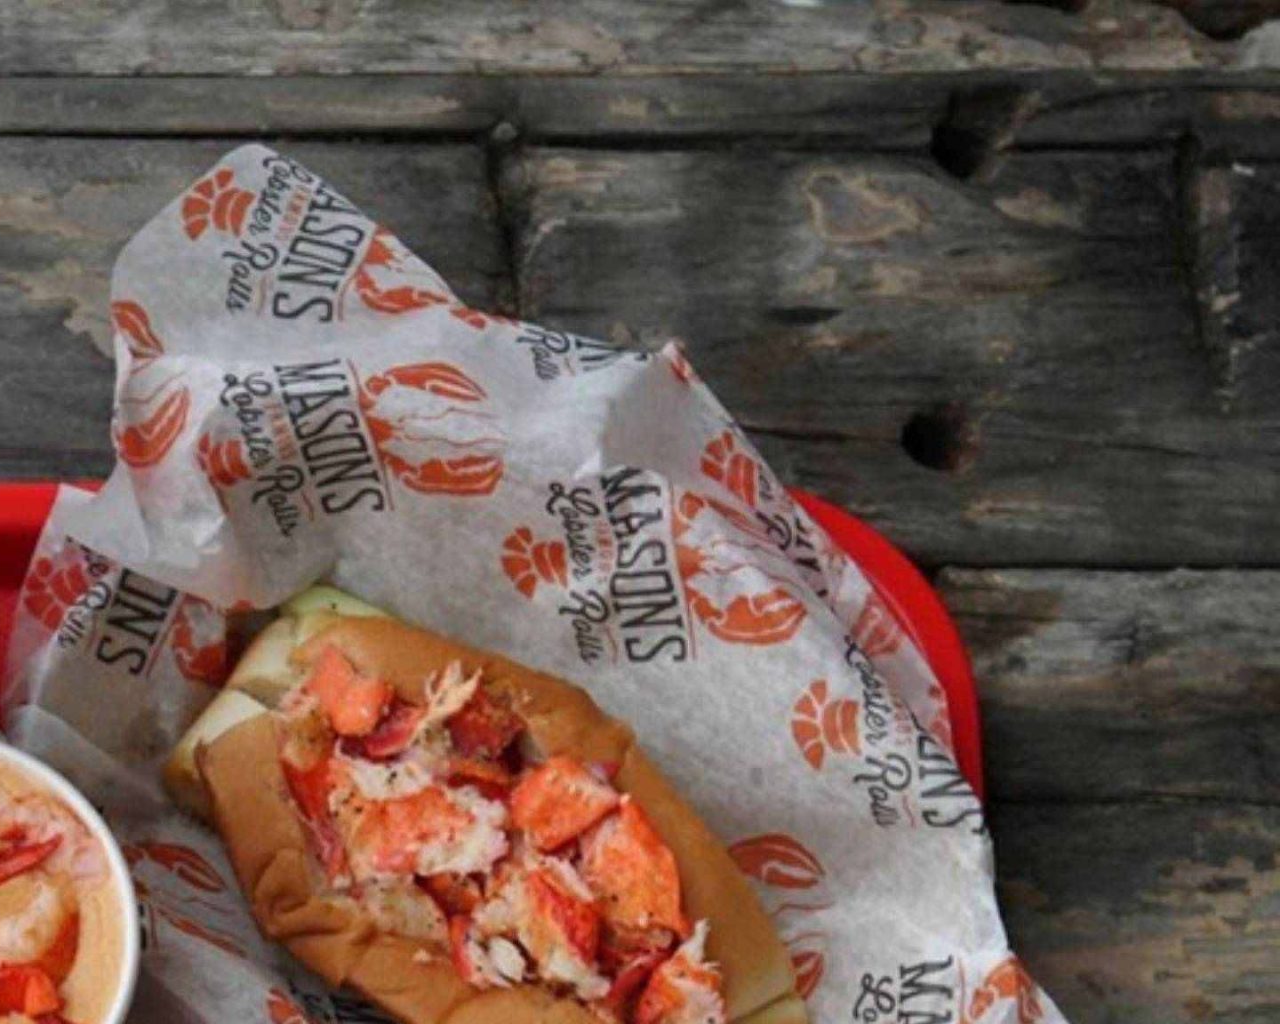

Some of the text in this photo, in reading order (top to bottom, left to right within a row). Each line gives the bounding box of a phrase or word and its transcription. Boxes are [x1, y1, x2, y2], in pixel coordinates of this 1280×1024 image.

[273, 357, 386, 514] MASONS
[251, 464, 306, 538] Rolls
[600, 466, 688, 663] MASONS
[558, 588, 611, 666] Rolls
